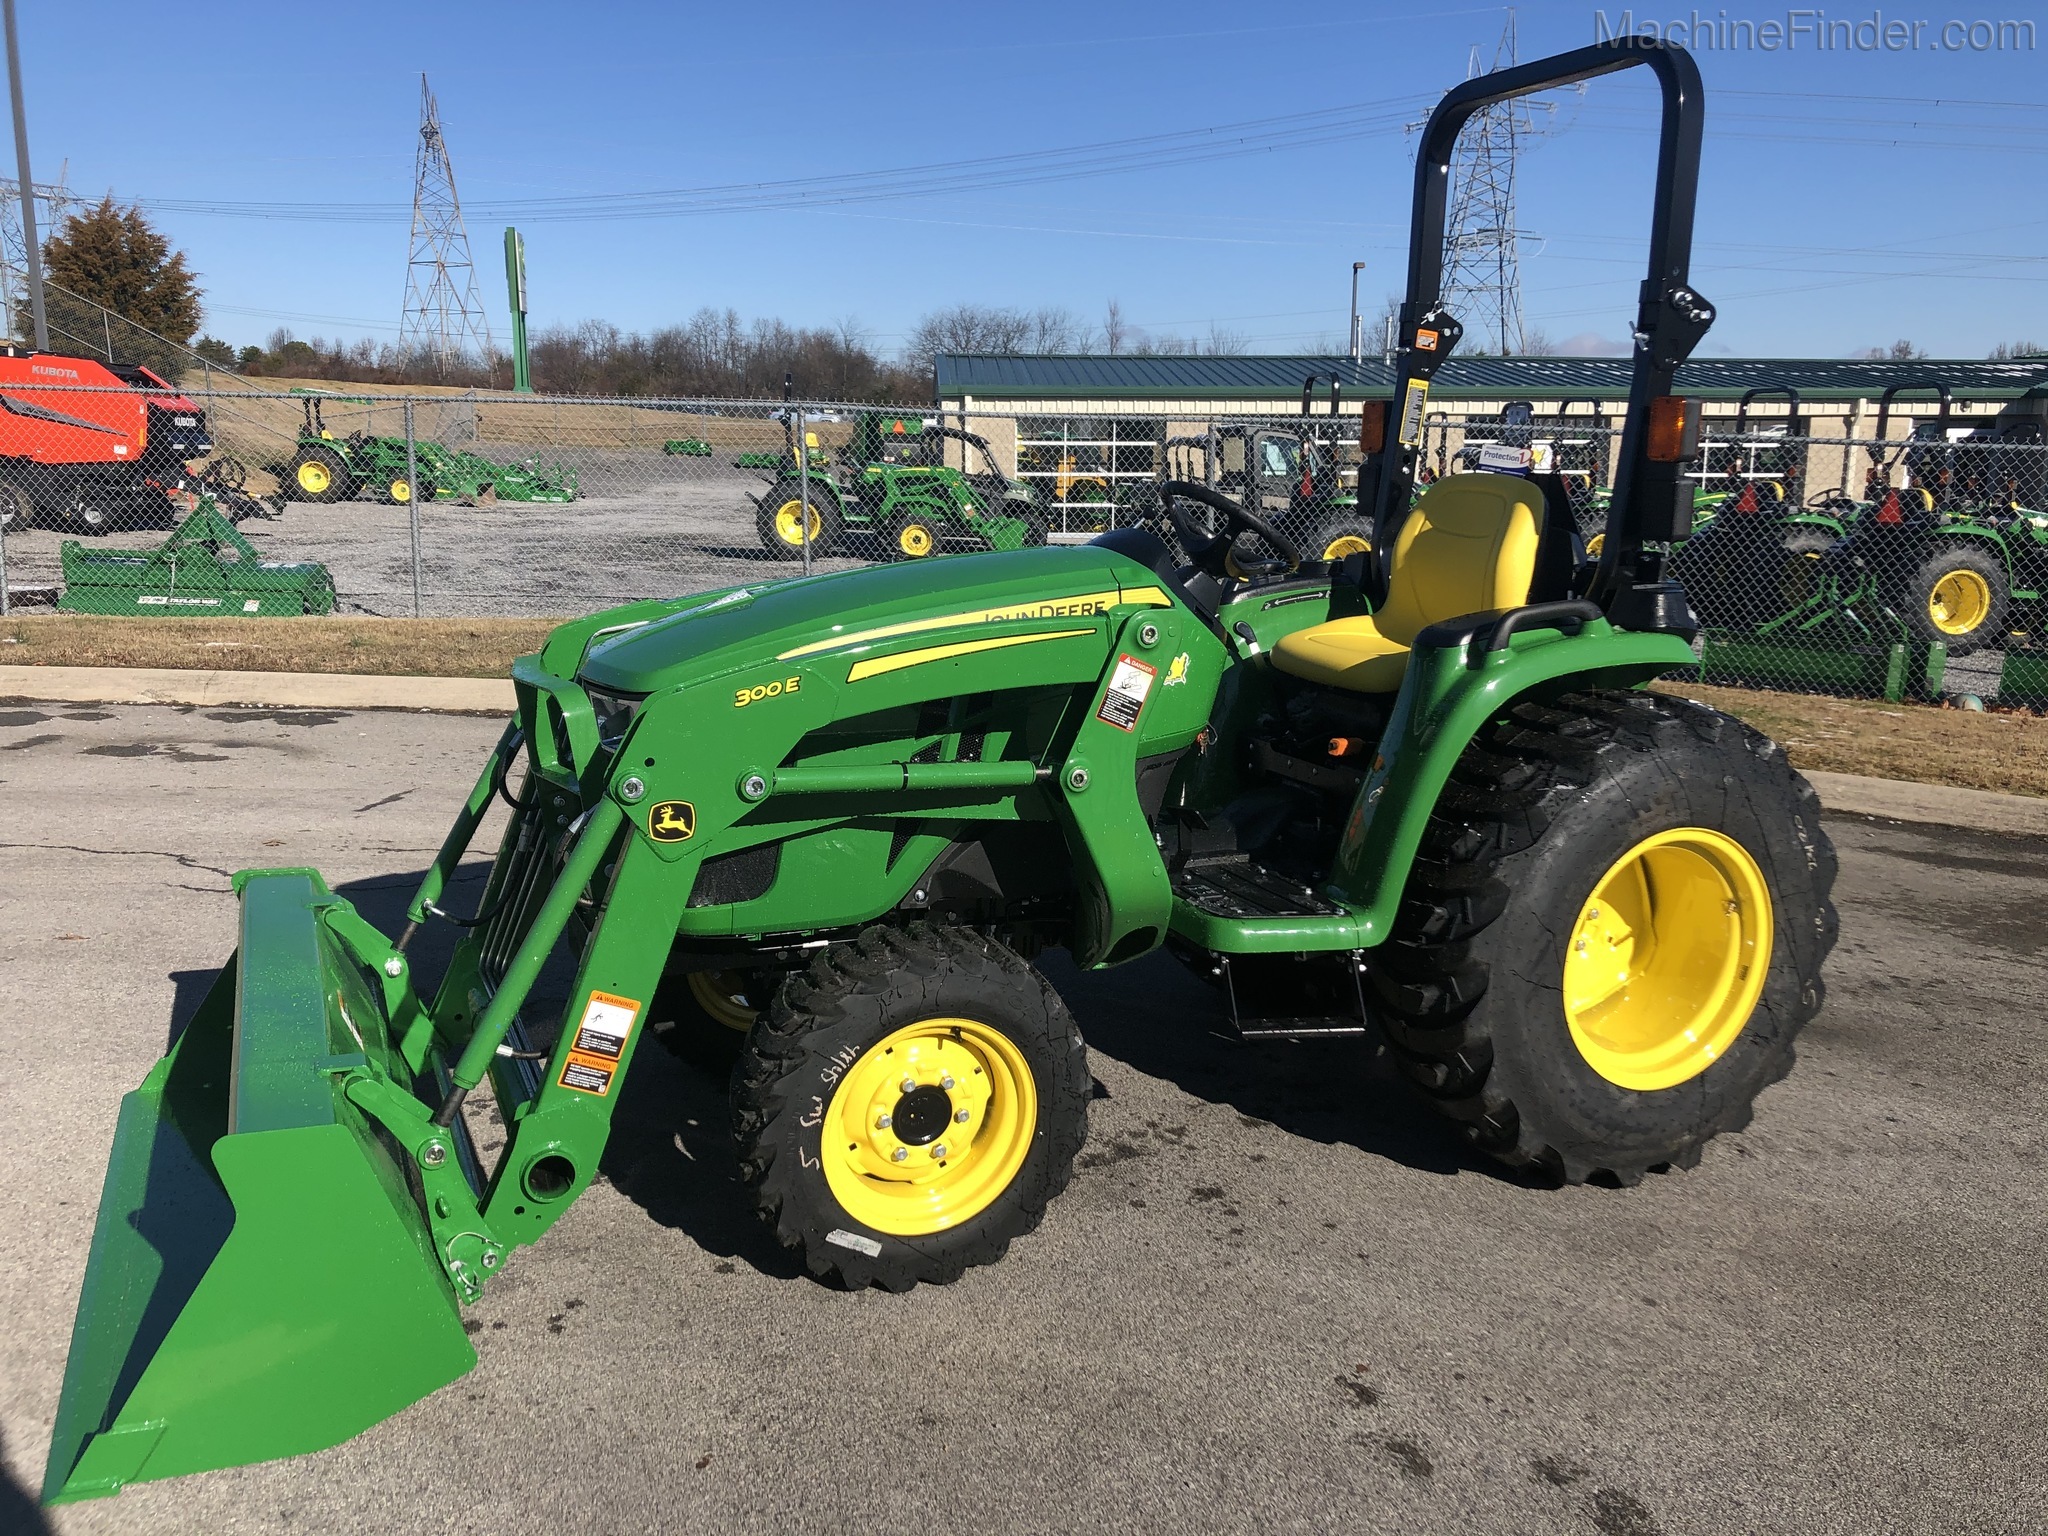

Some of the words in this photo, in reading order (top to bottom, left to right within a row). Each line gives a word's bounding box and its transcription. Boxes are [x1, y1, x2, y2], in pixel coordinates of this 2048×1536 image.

[32, 364, 79, 379] KUBOTA
[175, 417, 196, 427] KUBOTA
[1484, 450, 1520, 462] Protection
[1131, 660, 1153, 674] DANGER
[604, 996, 634, 1009] WARNING
[581, 1057, 611, 1070] WARNING
